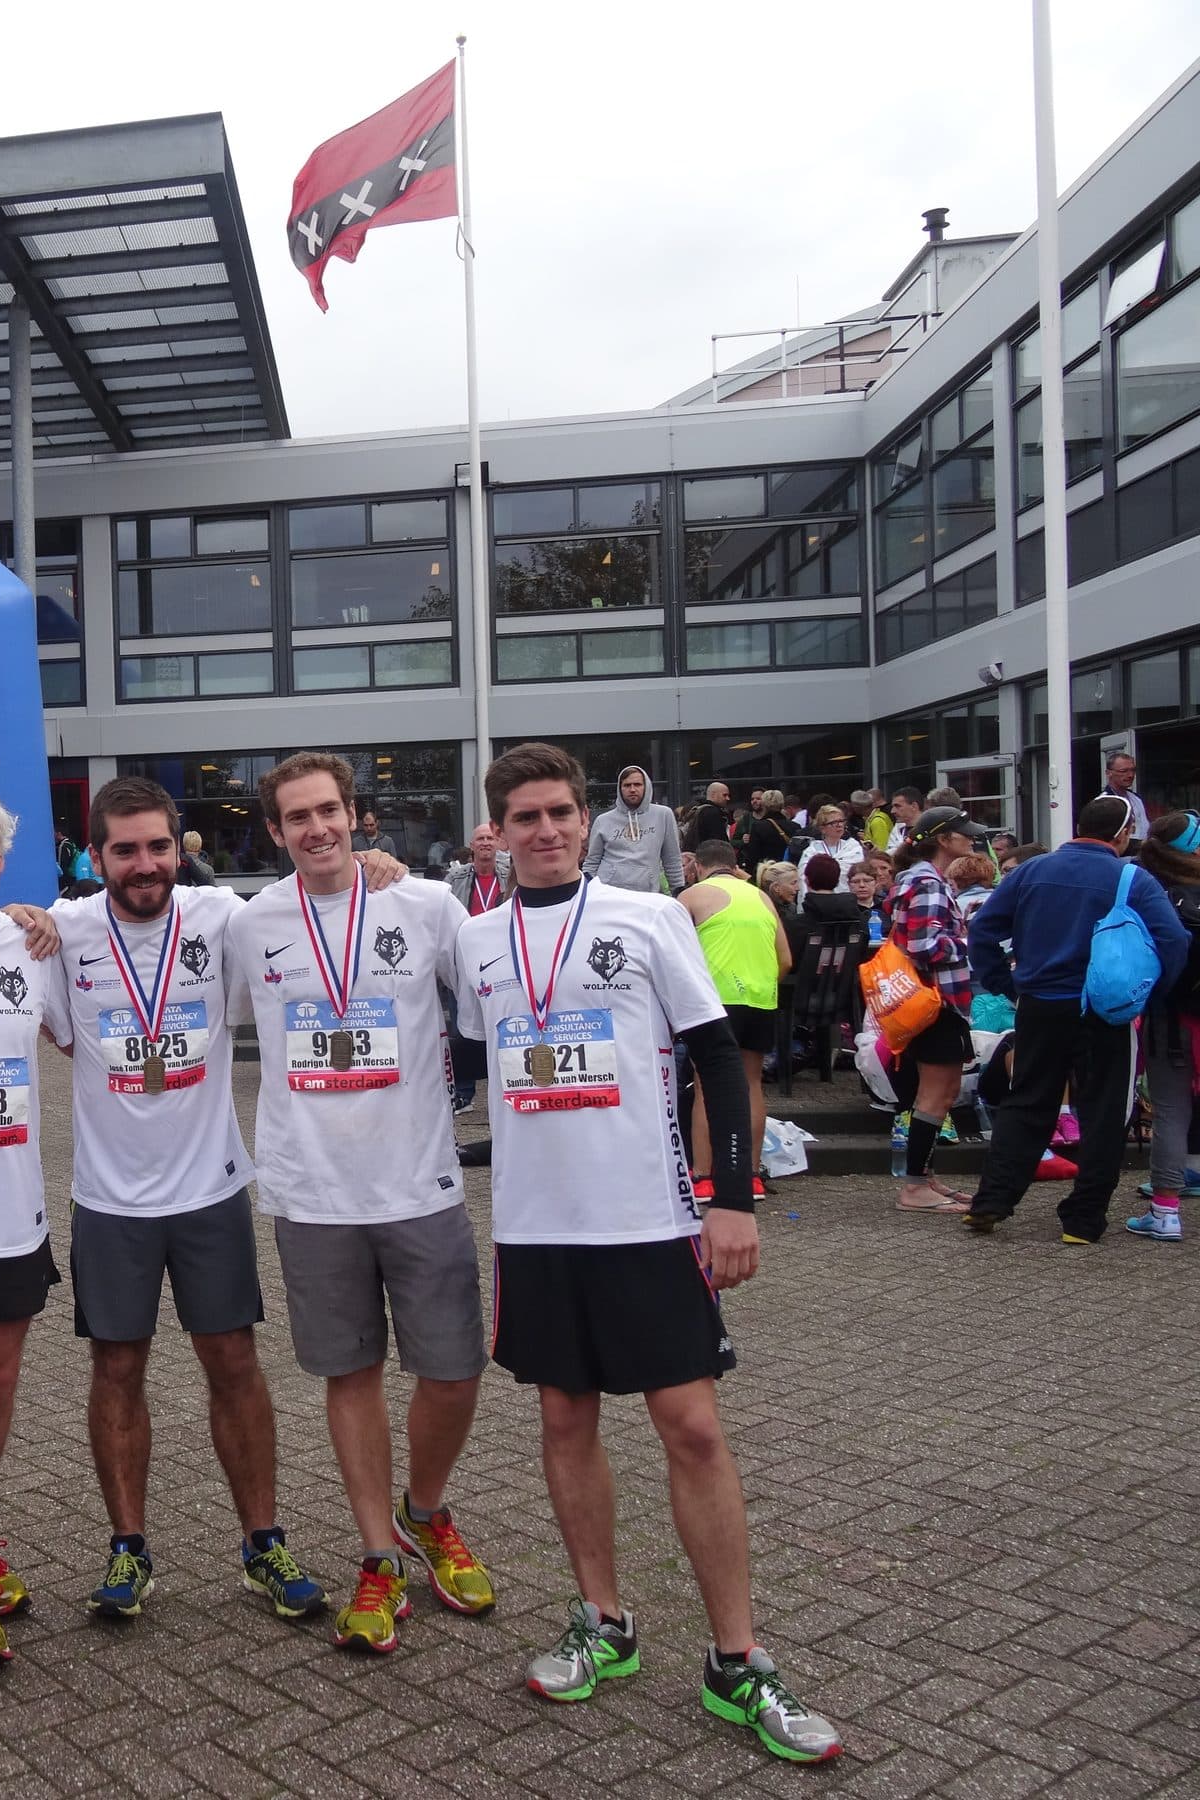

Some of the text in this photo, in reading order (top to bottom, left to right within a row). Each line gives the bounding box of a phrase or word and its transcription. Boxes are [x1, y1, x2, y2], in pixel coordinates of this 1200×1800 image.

[371, 969, 414, 977] WOLFPACK
[582, 983, 632, 991] WOLFPACK
[163, 1005, 183, 1014] ATA
[330, 1009, 387, 1019] CSULTANCY
[161, 1013, 199, 1024] SULTANCY
[340, 1018, 377, 1028] SERVICES
[558, 1013, 584, 1023] TATA
[160, 1021, 190, 1031] ERVICES
[293, 1020, 322, 1029] TATA
[543, 1021, 603, 1033] CONSULTANCY
[108, 1026, 136, 1036] TATA
[503, 1035, 533, 1046] TATA
[553, 1031, 593, 1042] SERVICES
[125, 1032, 188, 1062] 8625
[313, 1029, 372, 1057] 93
[167, 1060, 180, 1069] van
[292, 1059, 323, 1069] Rodrigo
[362, 1057, 395, 1067] Wersch
[506, 1077, 536, 1089] Santiag
[561, 1075, 577, 1084] van
[578, 1072, 615, 1083] Wersch
